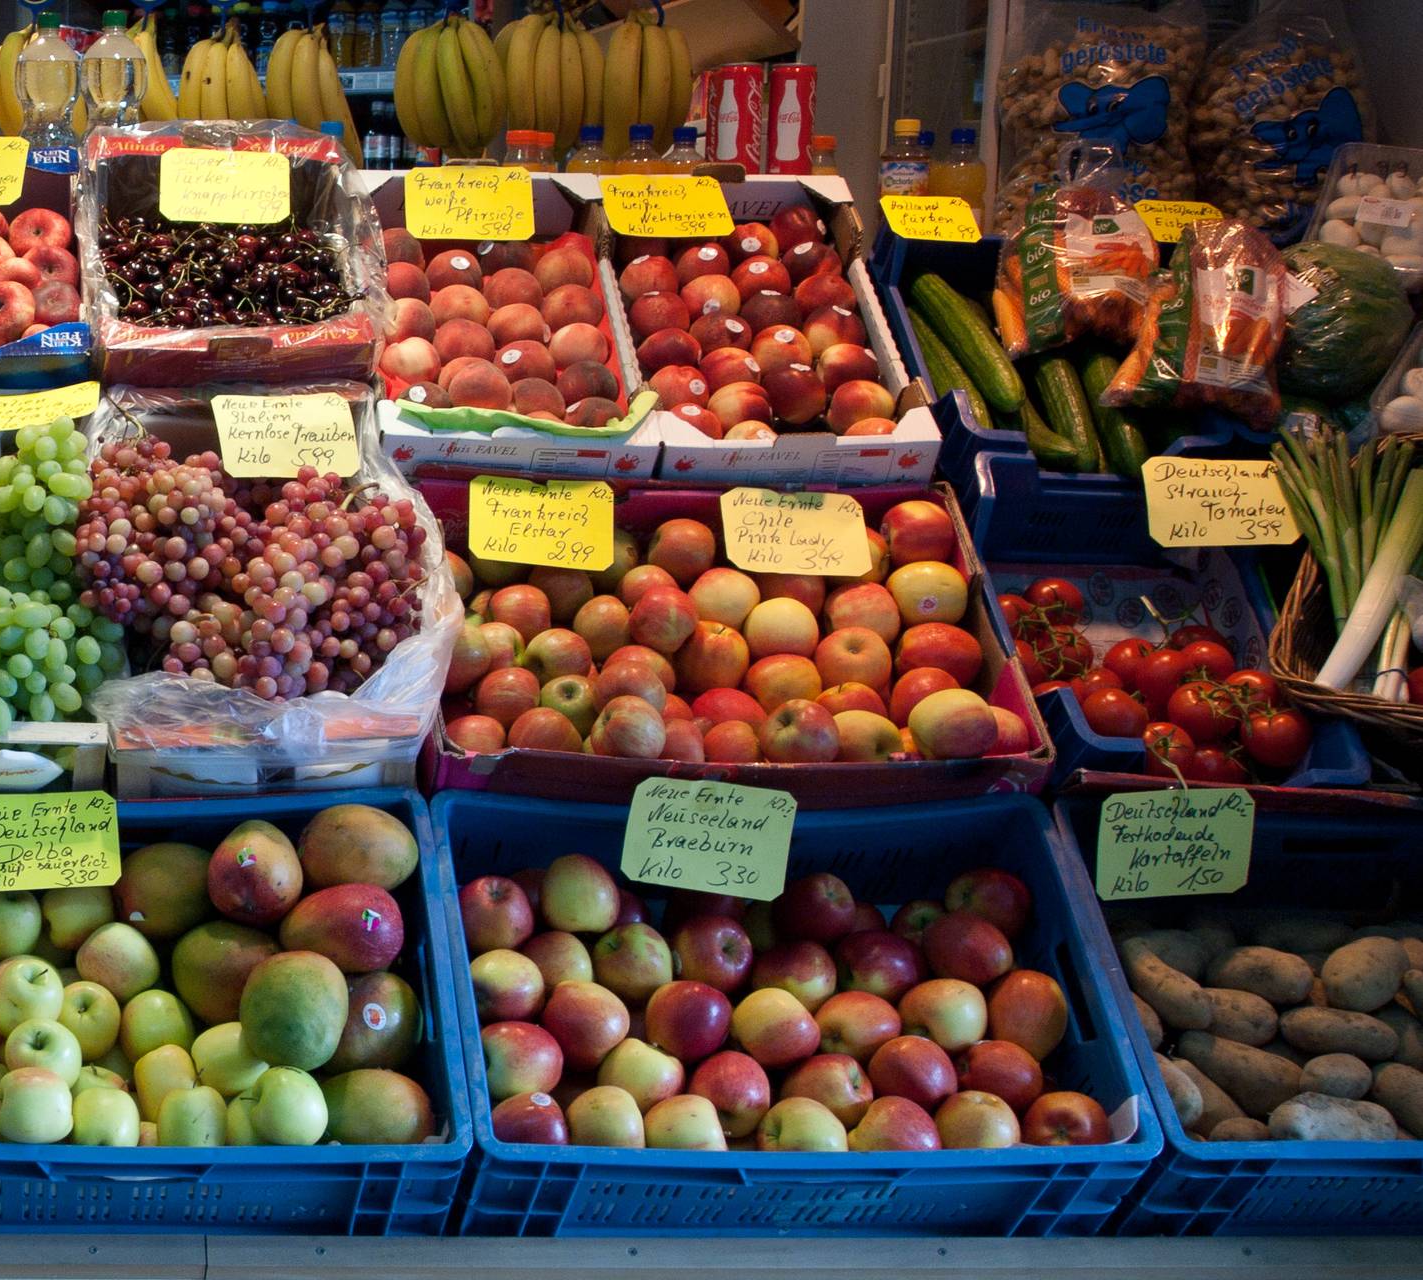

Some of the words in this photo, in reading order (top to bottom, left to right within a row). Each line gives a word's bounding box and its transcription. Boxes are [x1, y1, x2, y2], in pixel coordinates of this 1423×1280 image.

[1061, 40, 1168, 73] geröstete
[34, 156, 70, 165] FEIN
[414, 173, 499, 193] Frankreich
[607, 183, 687, 200] Frankreich
[421, 224, 453, 236] Kilo
[628, 223, 655, 234] Kilo
[1027, 246, 1046, 264] bio
[1029, 288, 1052, 305] bio
[238, 447, 271, 465] Kilo
[476, 444, 519, 457] FAVEL
[1154, 461, 1270, 483] Deutschland
[482, 480, 522, 496] Neue
[529, 485, 574, 500] Ernte
[733, 492, 774, 507] Neue
[777, 495, 825, 511] Ernte
[1201, 499, 1287, 522] Tomaten
[486, 498, 589, 527] Frankreich
[742, 510, 793, 532] Chile
[510, 522, 573, 539] Elstar
[1169, 521, 1209, 541] Kilo
[483, 536, 518, 554] Kilo
[747, 547, 783, 564] Kilo
[646, 784, 690, 800] Neue
[695, 787, 745, 806] Ernte
[31, 798, 78, 818] Ernte
[648, 802, 770, 831] Neuseeland
[1105, 796, 1223, 825] Deutschland
[647, 828, 754, 856] Braeburn
[1129, 842, 1230, 870] Kartoffeln
[638, 855, 683, 879] Kilo
[707, 861, 759, 886] 330
[1111, 871, 1150, 896] Kilo
